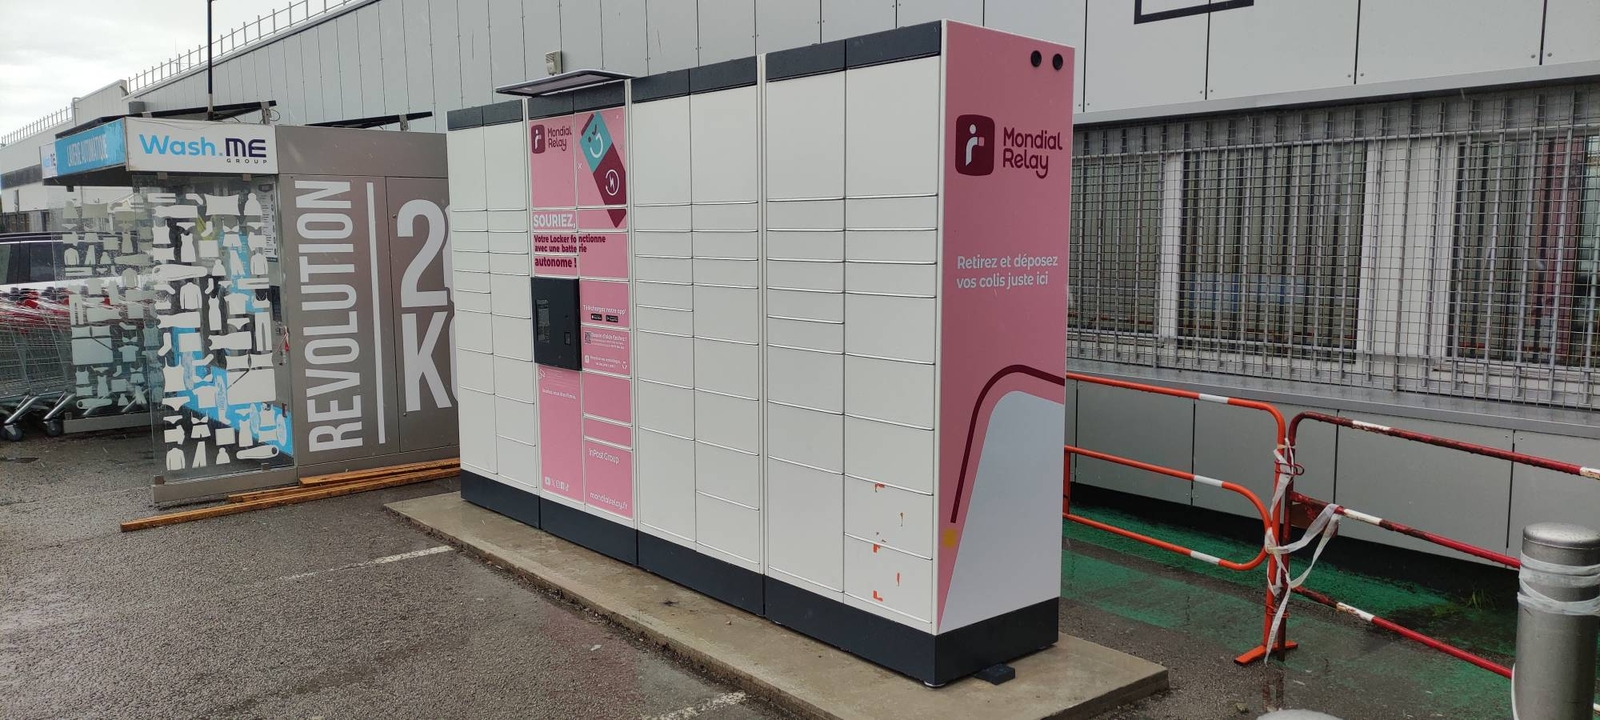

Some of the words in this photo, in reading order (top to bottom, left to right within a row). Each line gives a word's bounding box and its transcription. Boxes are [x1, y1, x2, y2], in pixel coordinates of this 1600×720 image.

[548, 126, 572, 138] Mondial
[1003, 127, 1063, 151] Mondial
[547, 137, 567, 151] Relay
[1003, 148, 1049, 179] Relay
[533, 214, 575, 228] SOURIEZ,
[533, 234, 549, 243] Votre
[550, 234, 570, 244] Locker
[534, 244, 548, 252] avec
[397, 199, 452, 308] 2
[534, 257, 573, 268] autonome
[957, 255, 998, 270] Retirez
[1000, 255, 1012, 269] et
[1013, 253, 1058, 271] déposez
[956, 277, 977, 289] vos
[979, 274, 1006, 288] colis
[1006, 272, 1034, 290] juste
[1036, 271, 1049, 286] ici
[294, 180, 364, 452] REVOLUTION
[401, 311, 459, 412] K
